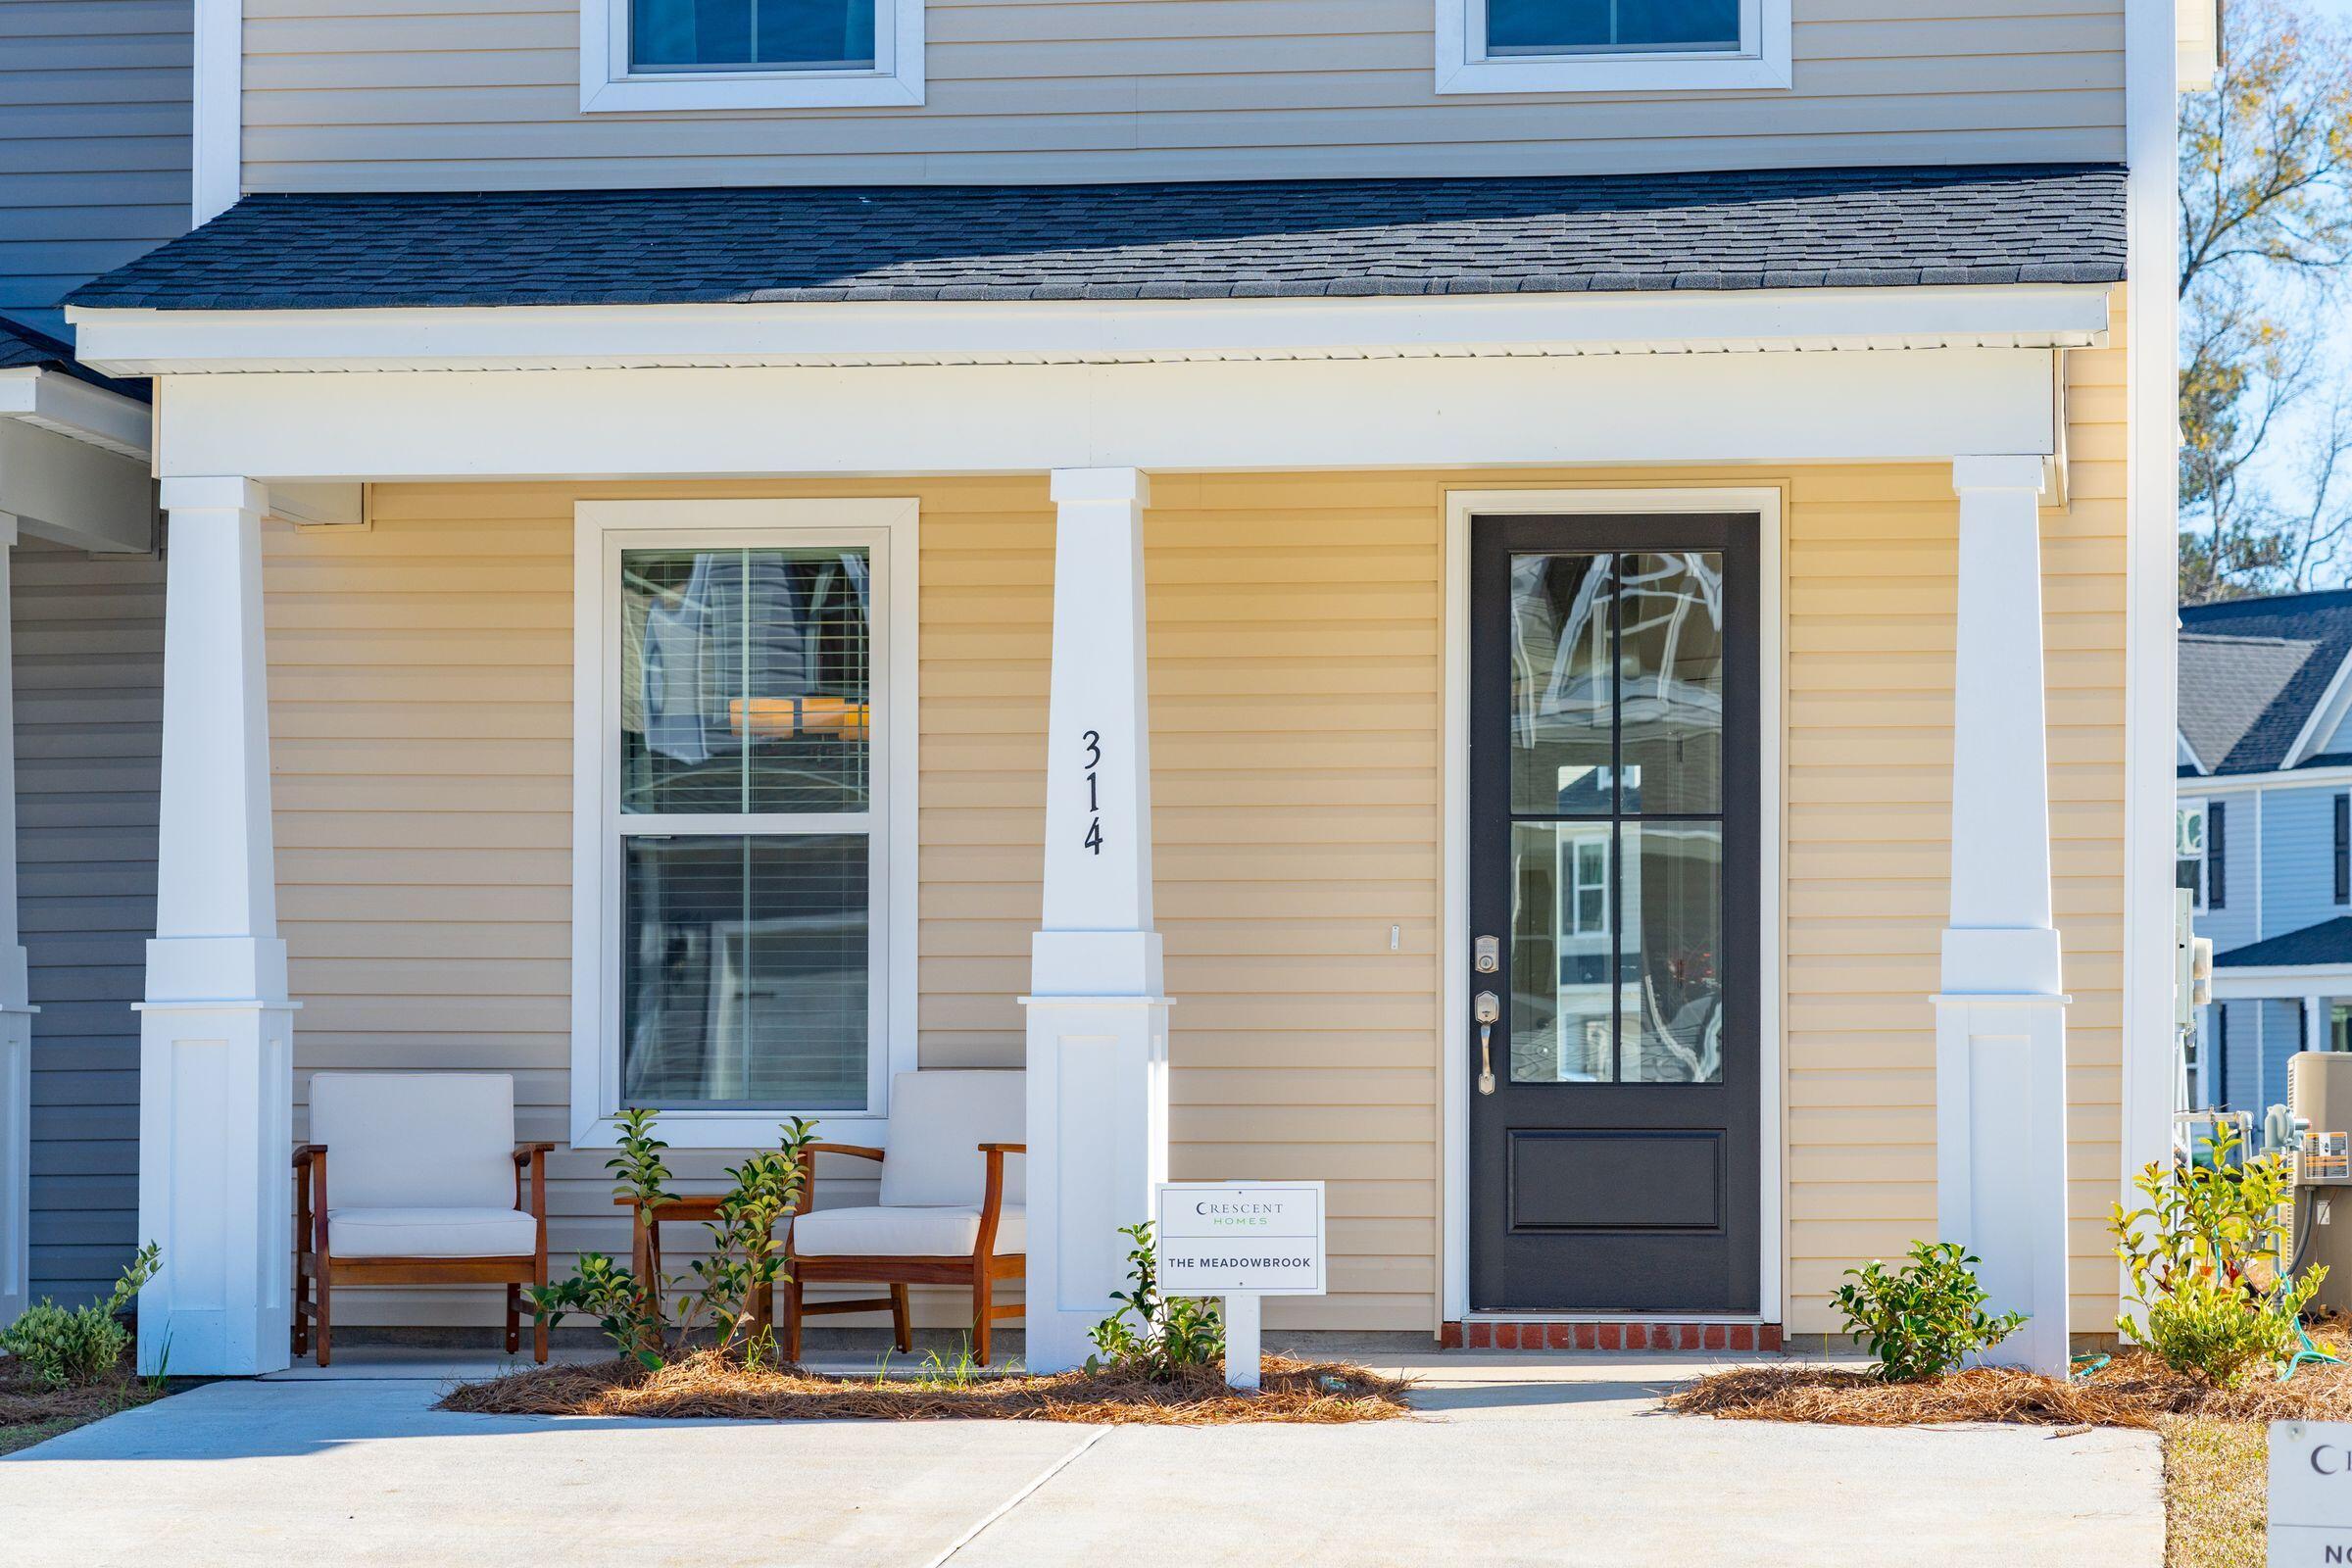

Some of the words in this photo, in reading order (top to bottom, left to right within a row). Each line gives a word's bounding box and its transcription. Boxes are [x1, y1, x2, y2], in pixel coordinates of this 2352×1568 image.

[1082, 730, 1103, 856] 314
[1196, 1201, 1284, 1216] CRESCENT
[1168, 1258, 1195, 1268] THE
[1200, 1257, 1311, 1268] MEADOWBROOK
[2310, 1445, 2352, 1475] C
